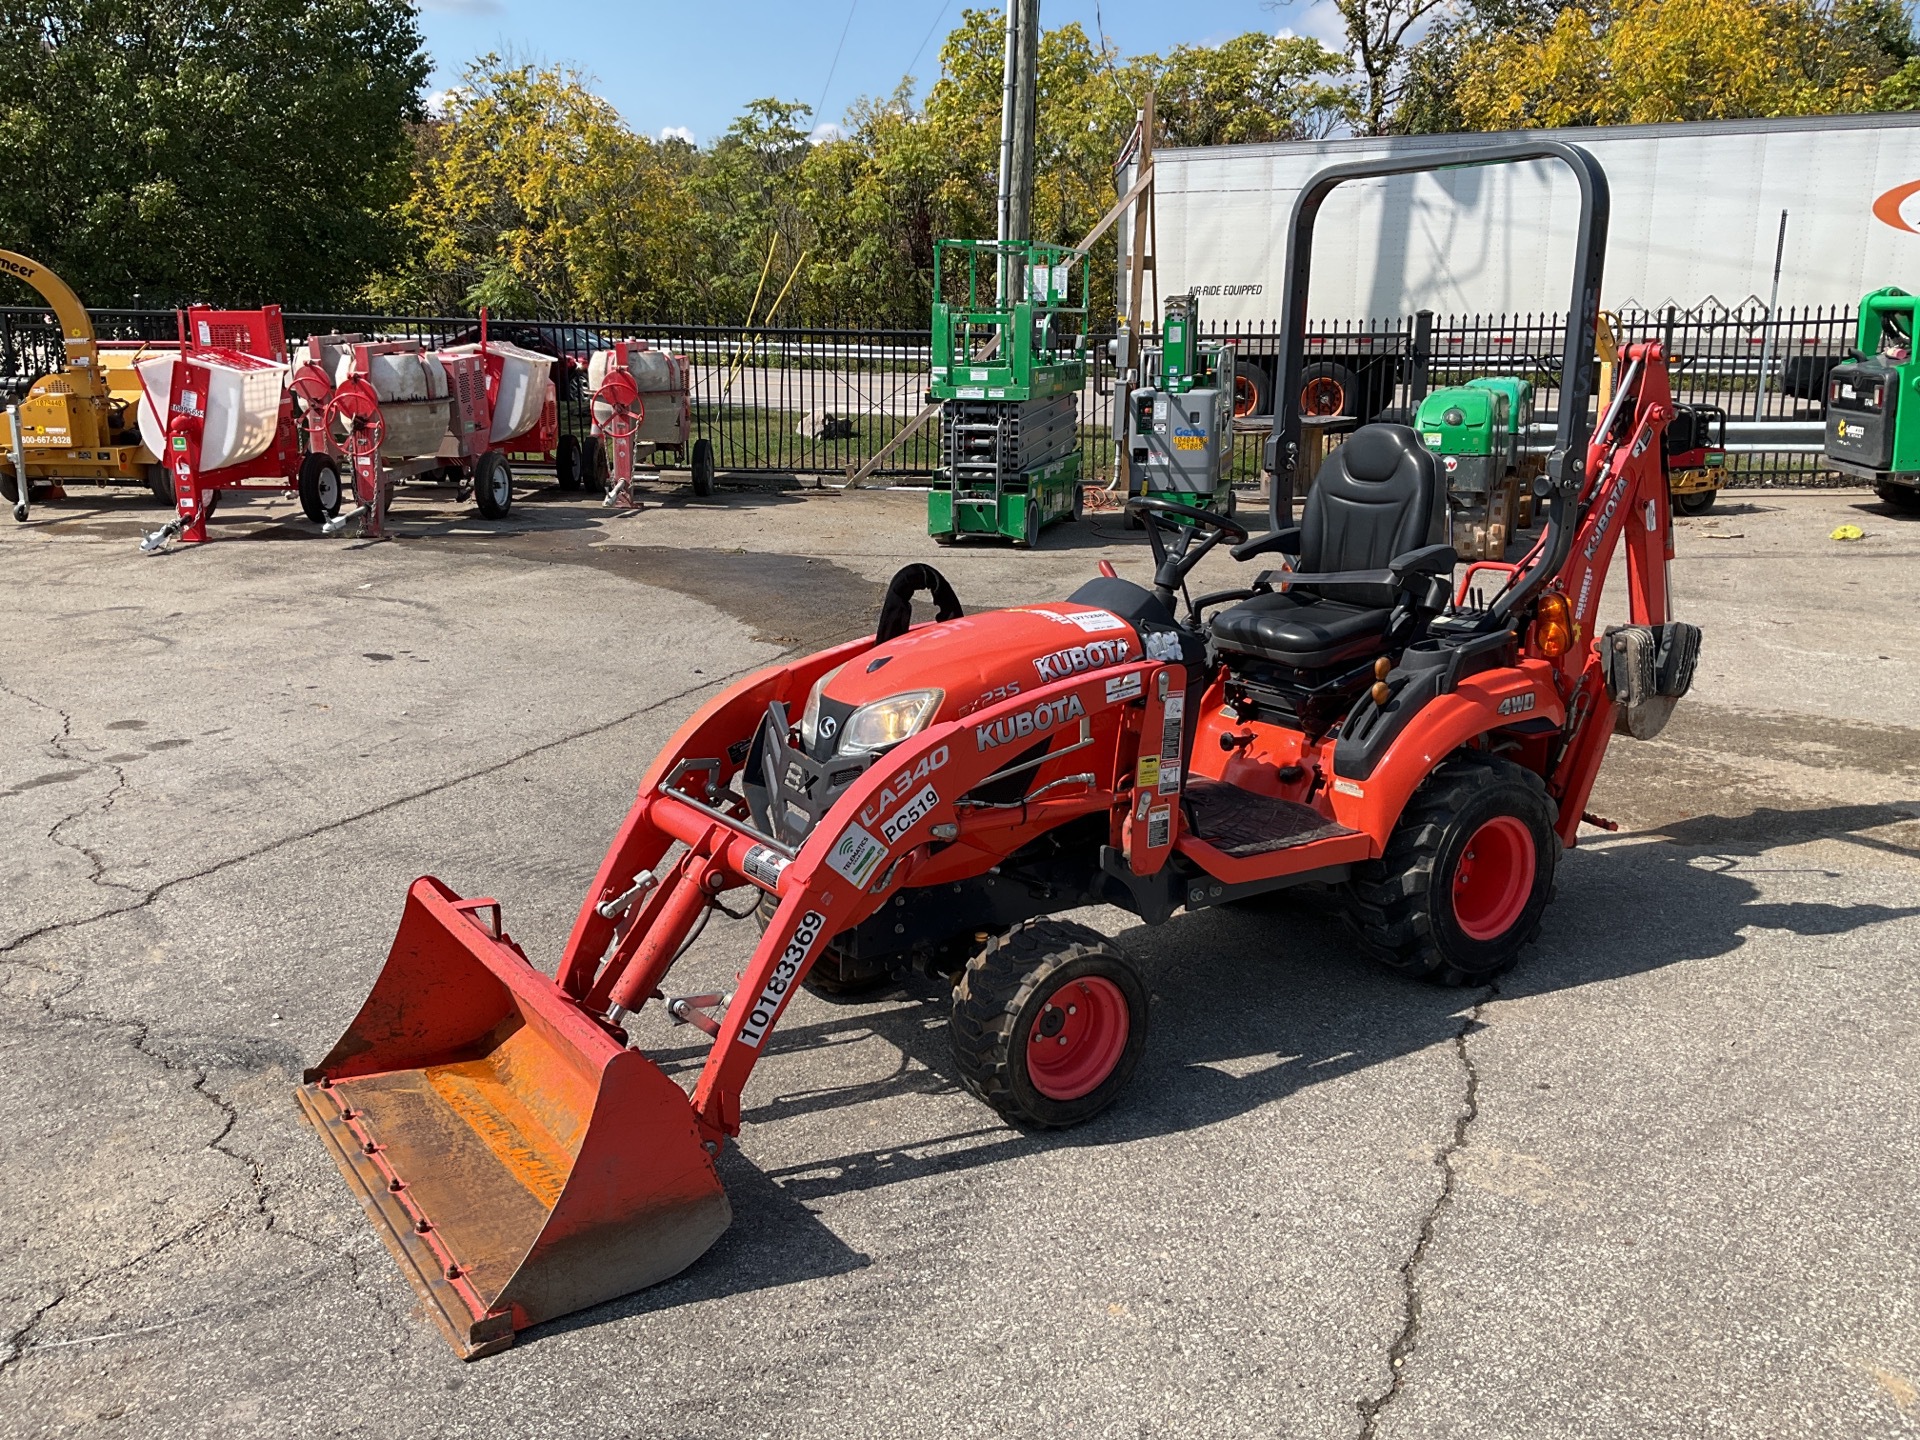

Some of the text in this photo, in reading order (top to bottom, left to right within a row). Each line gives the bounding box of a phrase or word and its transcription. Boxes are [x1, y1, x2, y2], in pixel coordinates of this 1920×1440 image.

[1188, 284, 1263, 296] AIR-RIDE EQUIPPED
[1175, 427, 1206, 436] Genie
[1584, 477, 1629, 561] KUBOTA
[1575, 565, 1592, 620] SUNBELT
[1033, 638, 1130, 683] KUBOTA
[975, 692, 1086, 752] KUBOTA
[1497, 692, 1535, 716] 4WD
[860, 745, 949, 828] LA340
[884, 790, 938, 843] PC519
[843, 836, 869, 871] TELEMATICS
[741, 911, 822, 1040] 10183369
